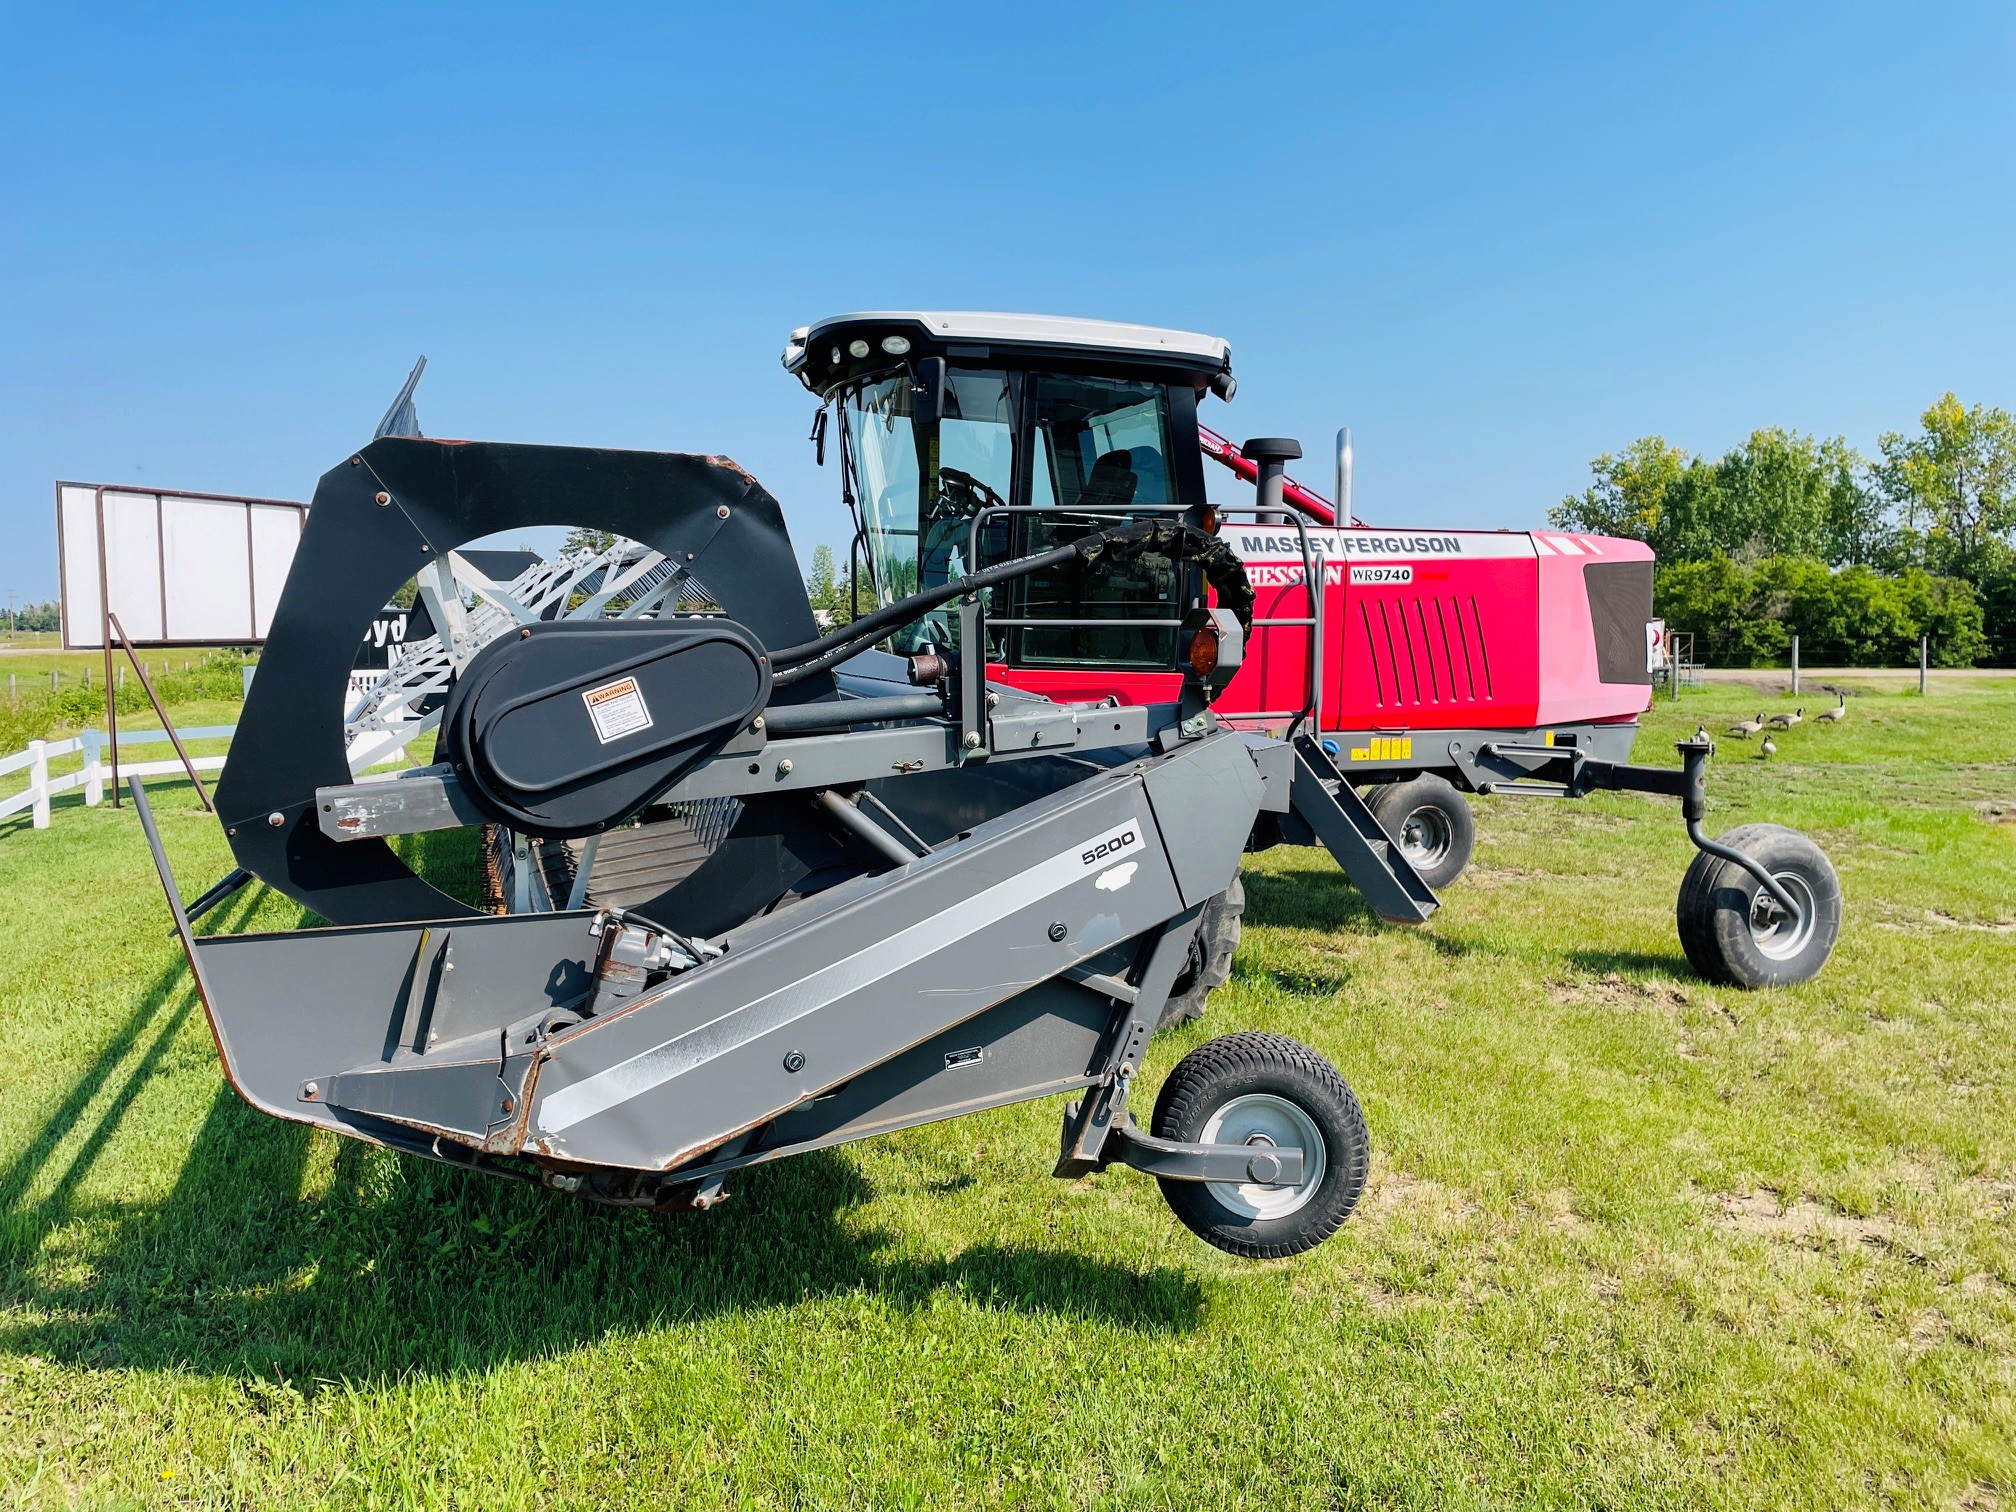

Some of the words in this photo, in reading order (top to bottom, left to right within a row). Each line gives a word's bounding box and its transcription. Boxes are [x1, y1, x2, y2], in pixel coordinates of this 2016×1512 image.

[1241, 537, 1335, 553] MASSEY
[1343, 537, 1462, 553] FERGUSON
[1245, 565, 1343, 586] HESSTN
[1353, 569, 1411, 581] WR9740
[598, 684, 632, 700] WARNING
[1081, 831, 1135, 865] 5200
